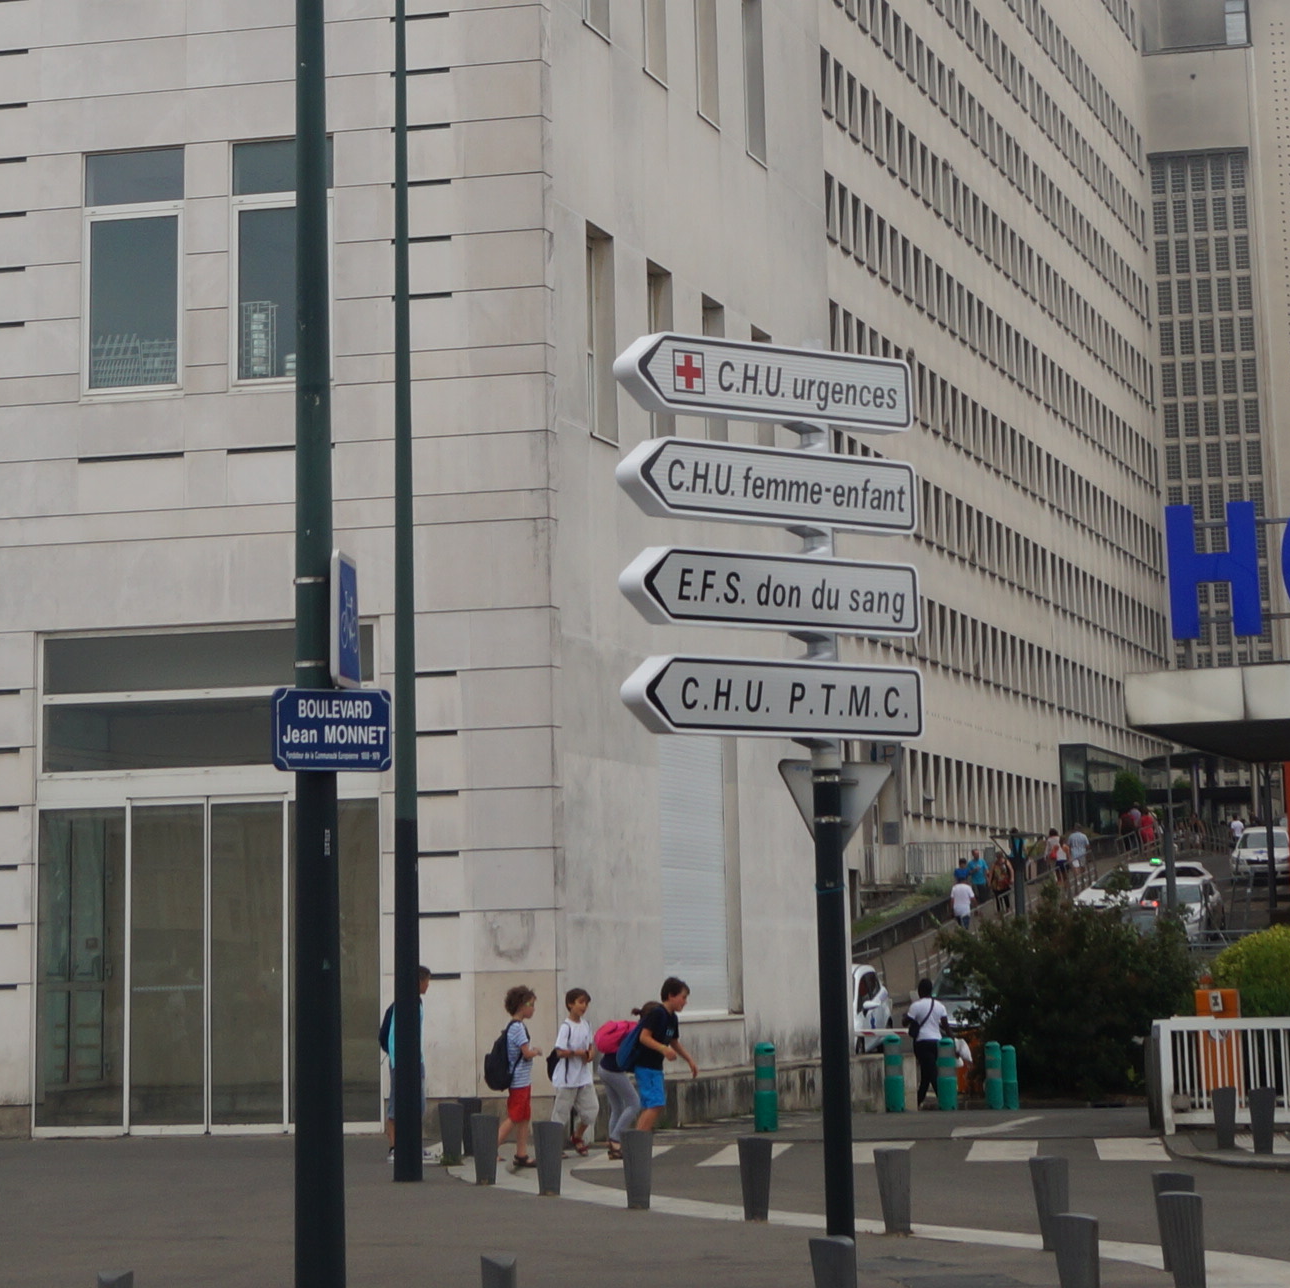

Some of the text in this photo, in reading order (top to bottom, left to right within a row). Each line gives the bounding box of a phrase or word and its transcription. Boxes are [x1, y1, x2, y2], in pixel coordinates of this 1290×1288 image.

[717, 360, 898, 411] C.H.U. urgences
[667, 458, 906, 513] C.H.U. femme-enfant
[677, 568, 906, 623] E.F.S. don du sang
[298, 699, 372, 719] BOULEVARD
[680, 677, 909, 720] C.H.U. P.T.M.C.
[282, 724, 387, 745] Jean MONNET
